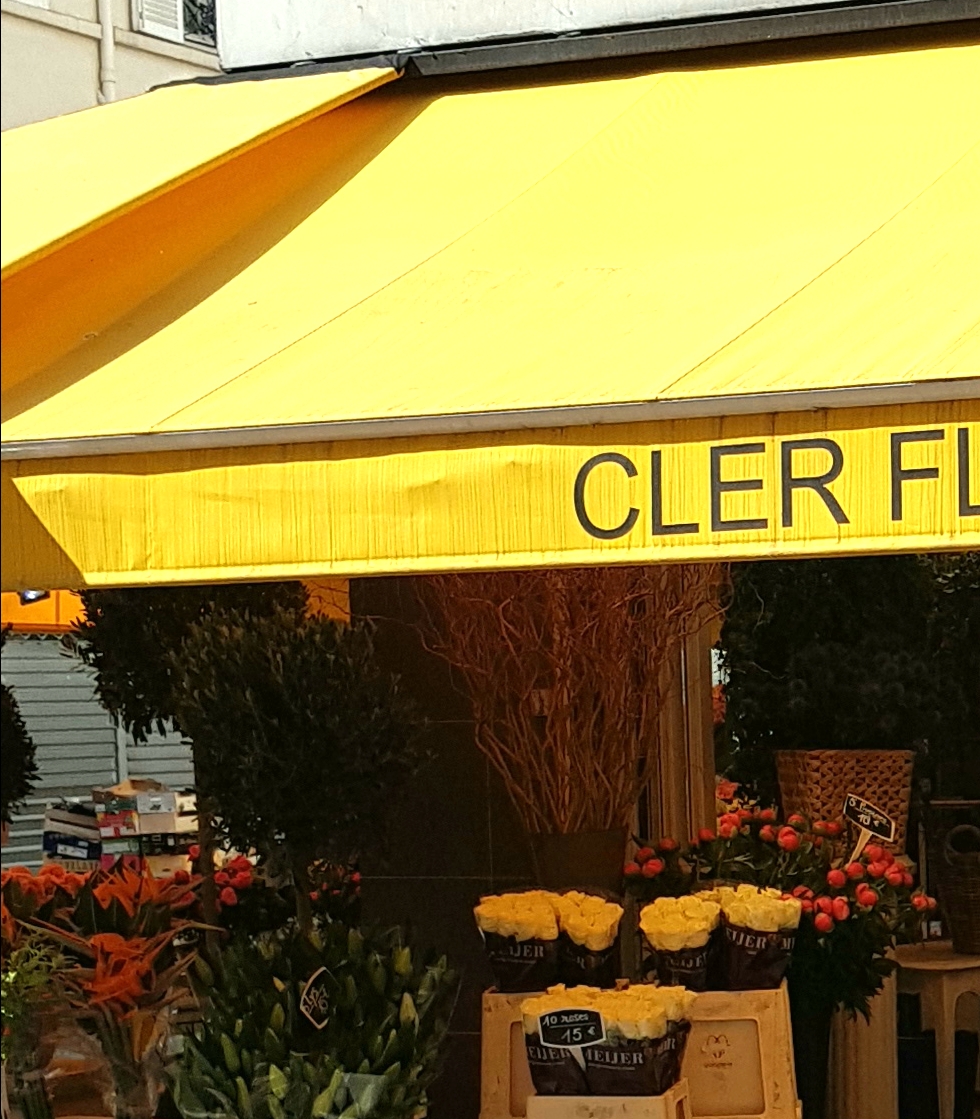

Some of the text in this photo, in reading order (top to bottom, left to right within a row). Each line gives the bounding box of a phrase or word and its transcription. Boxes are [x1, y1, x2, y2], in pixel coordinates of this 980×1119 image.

[573, 437, 850, 540] CLER
[543, 1012, 589, 1026] 10 roses
[561, 1028, 582, 1043] 15
